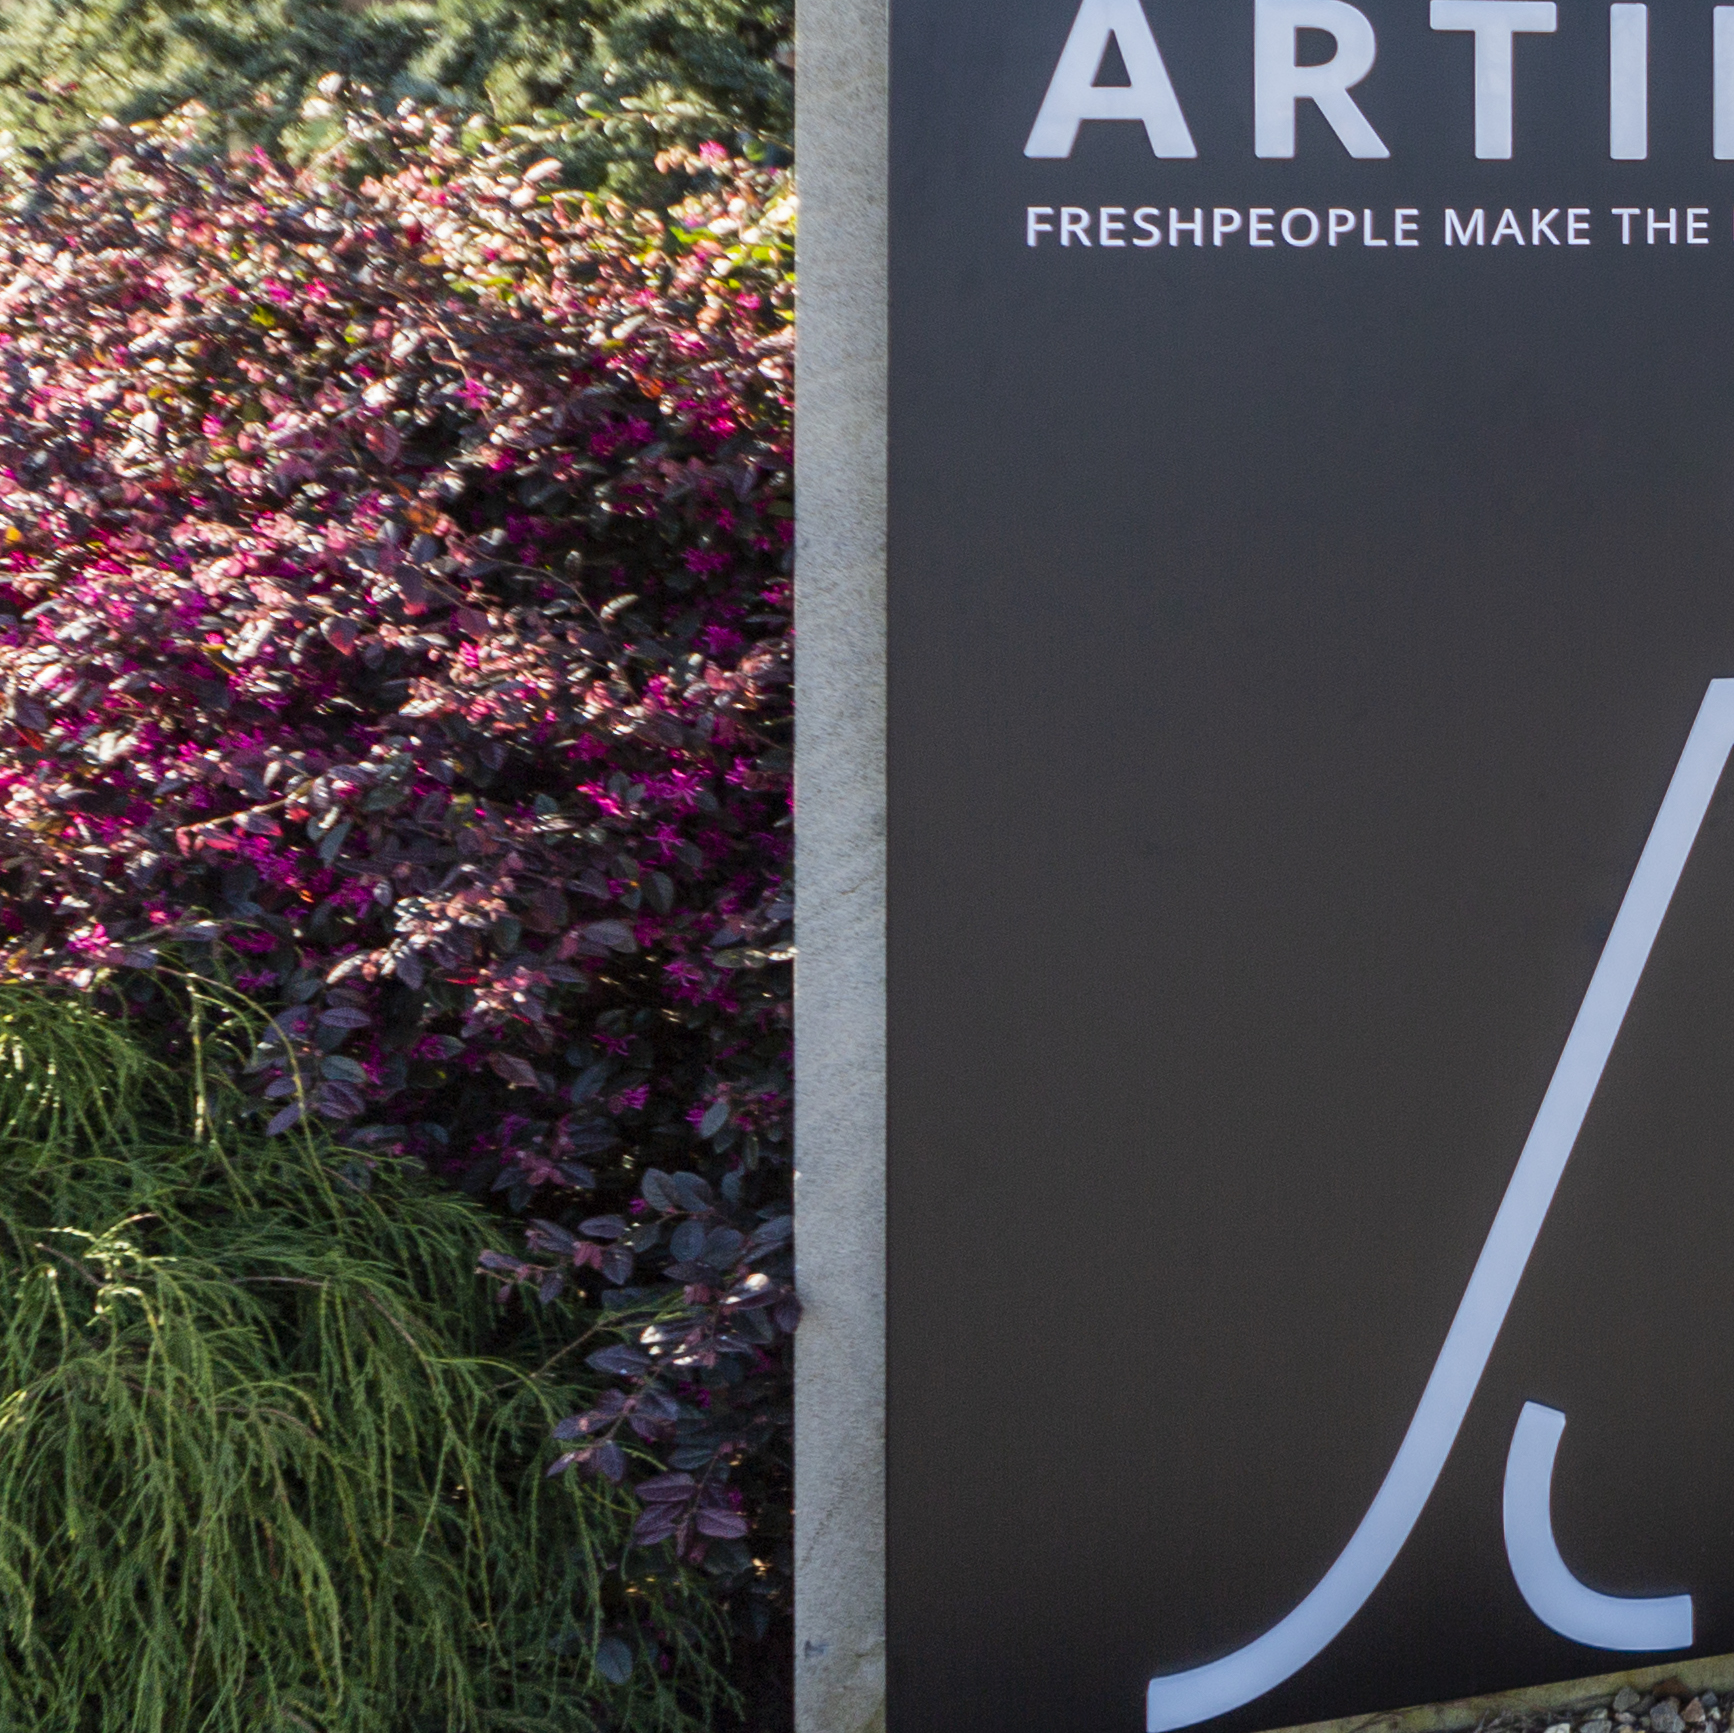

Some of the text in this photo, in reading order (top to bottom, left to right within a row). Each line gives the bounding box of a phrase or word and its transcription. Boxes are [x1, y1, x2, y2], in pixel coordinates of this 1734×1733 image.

[1025, 206, 1420, 248] FRESHPEOPLE
[1444, 207, 1592, 247] MAKE
[1611, 207, 1710, 245] THE
